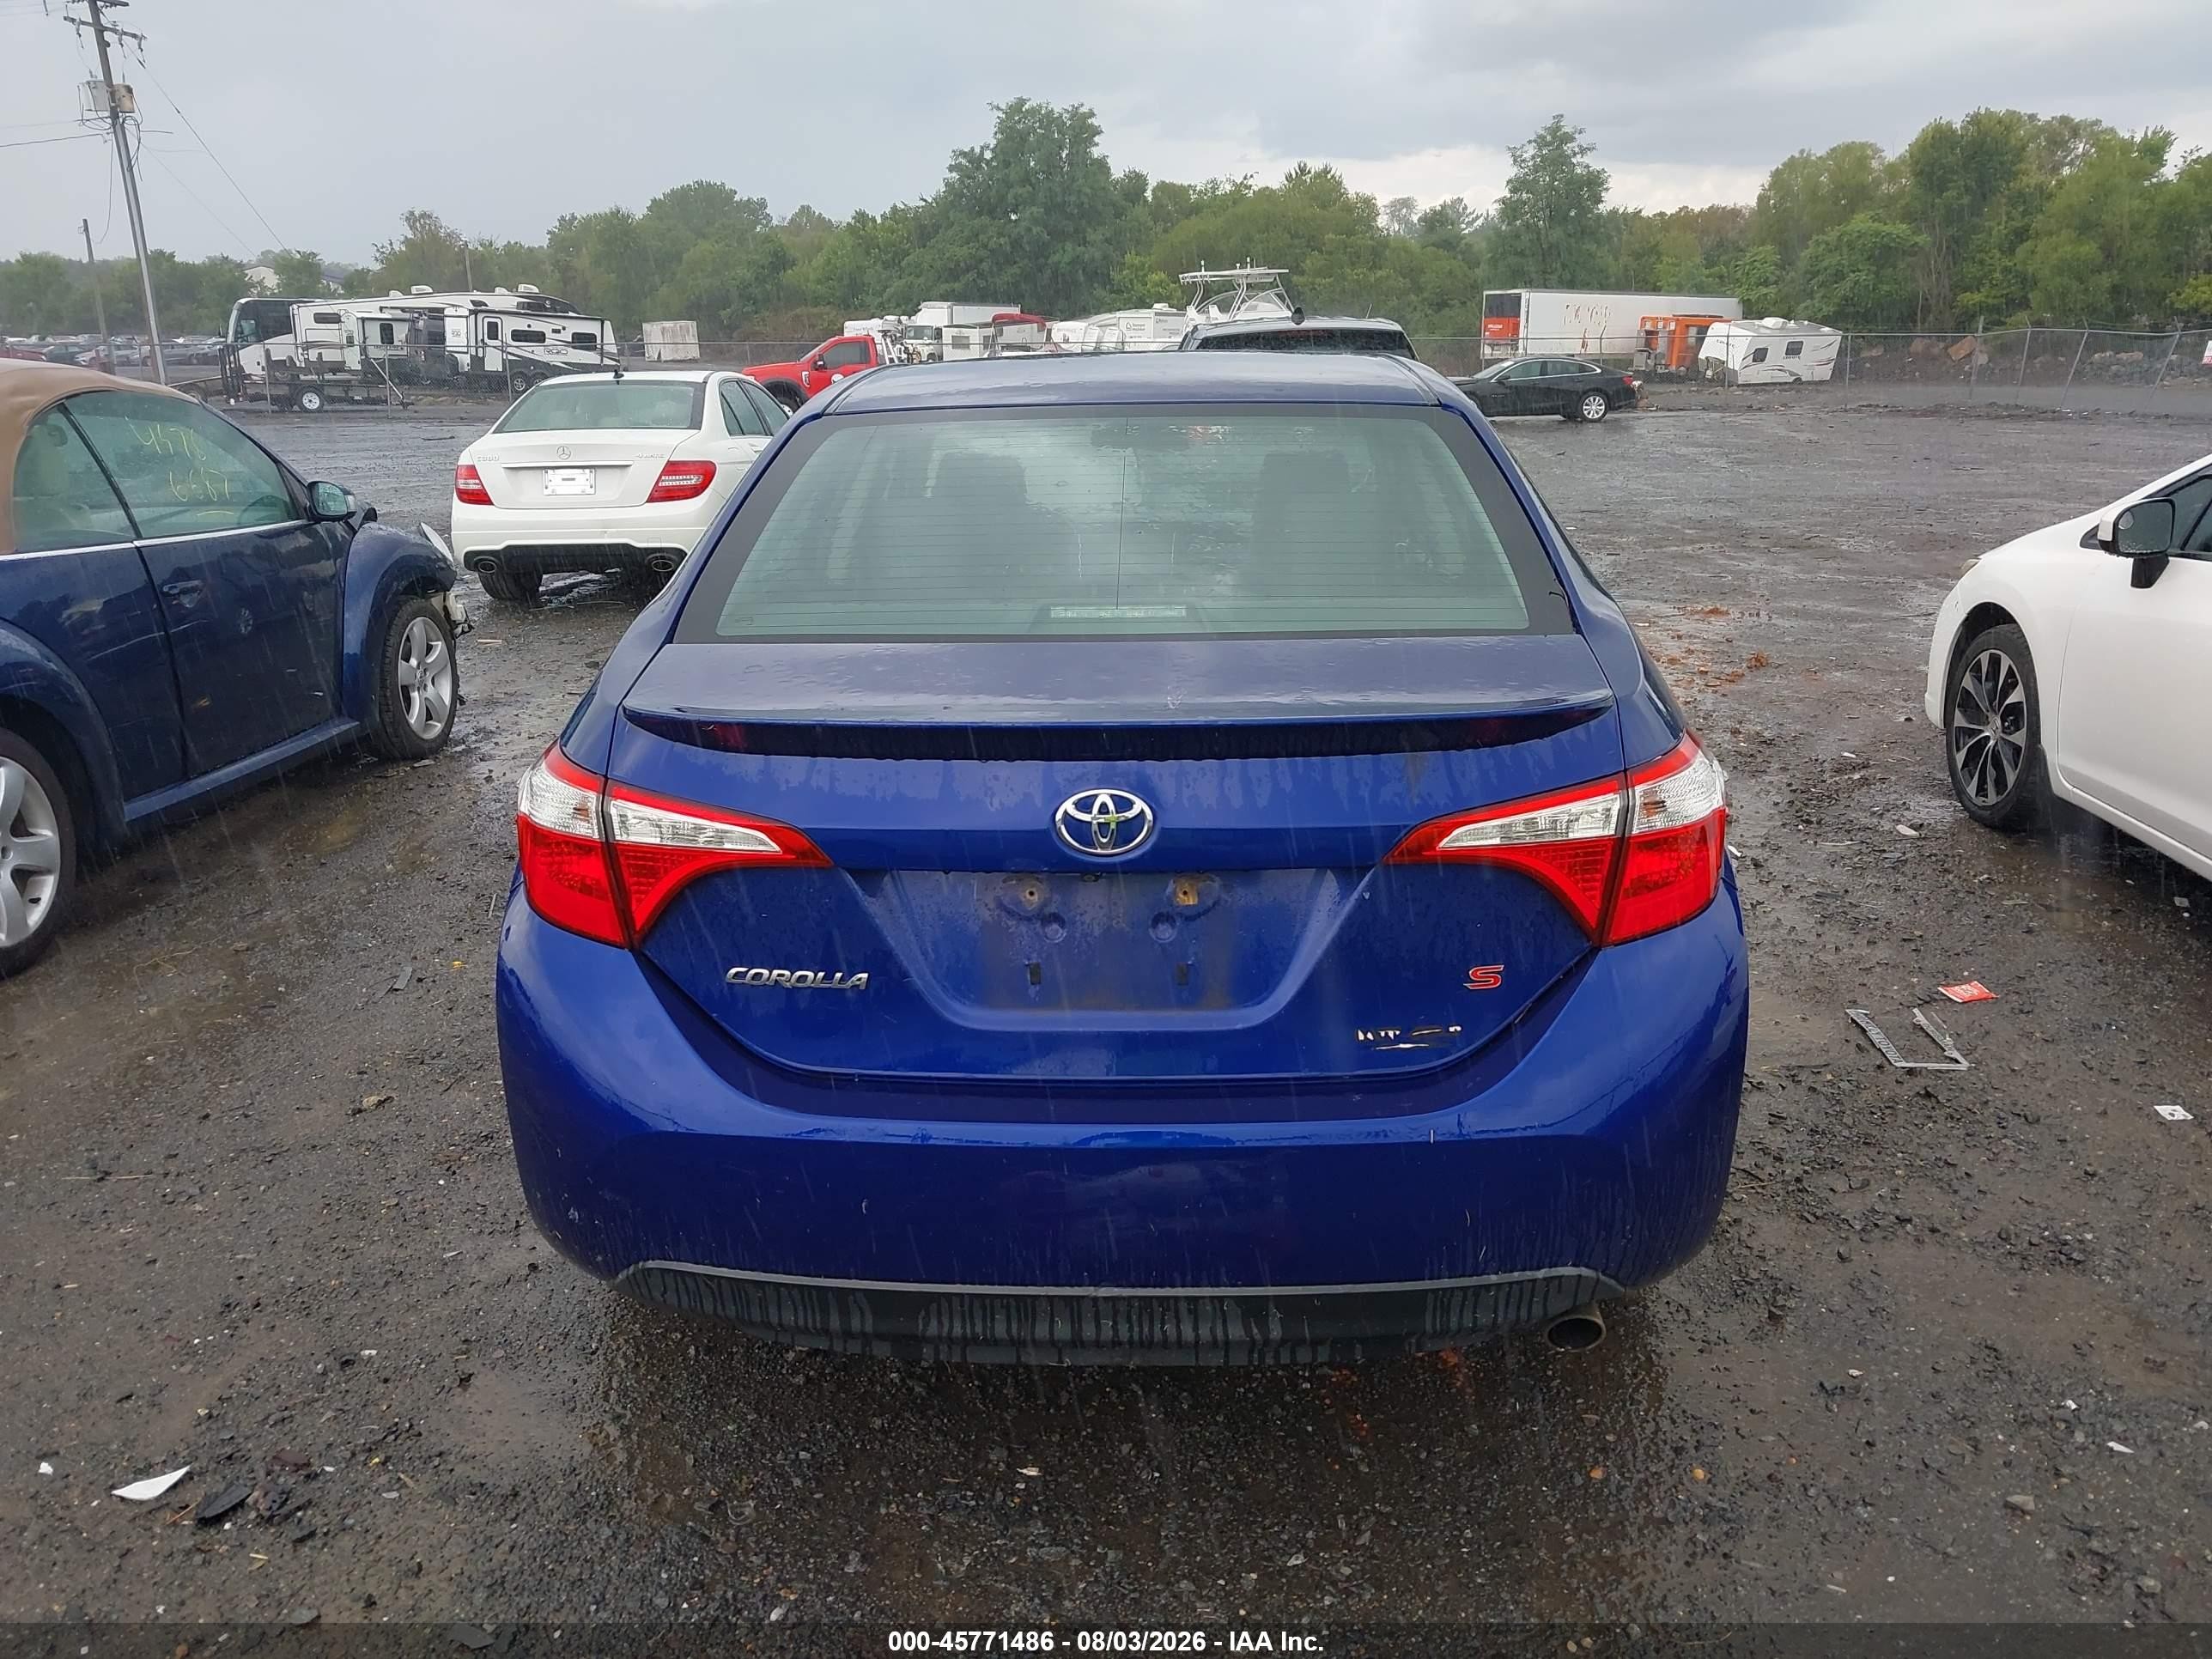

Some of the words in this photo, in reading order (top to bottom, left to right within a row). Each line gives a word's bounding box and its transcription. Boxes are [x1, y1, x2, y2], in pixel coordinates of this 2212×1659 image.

[726, 967, 869, 989] COROLLA
[1462, 964, 1504, 989] S
[1875, 1031, 1904, 1064] TOYOTA
